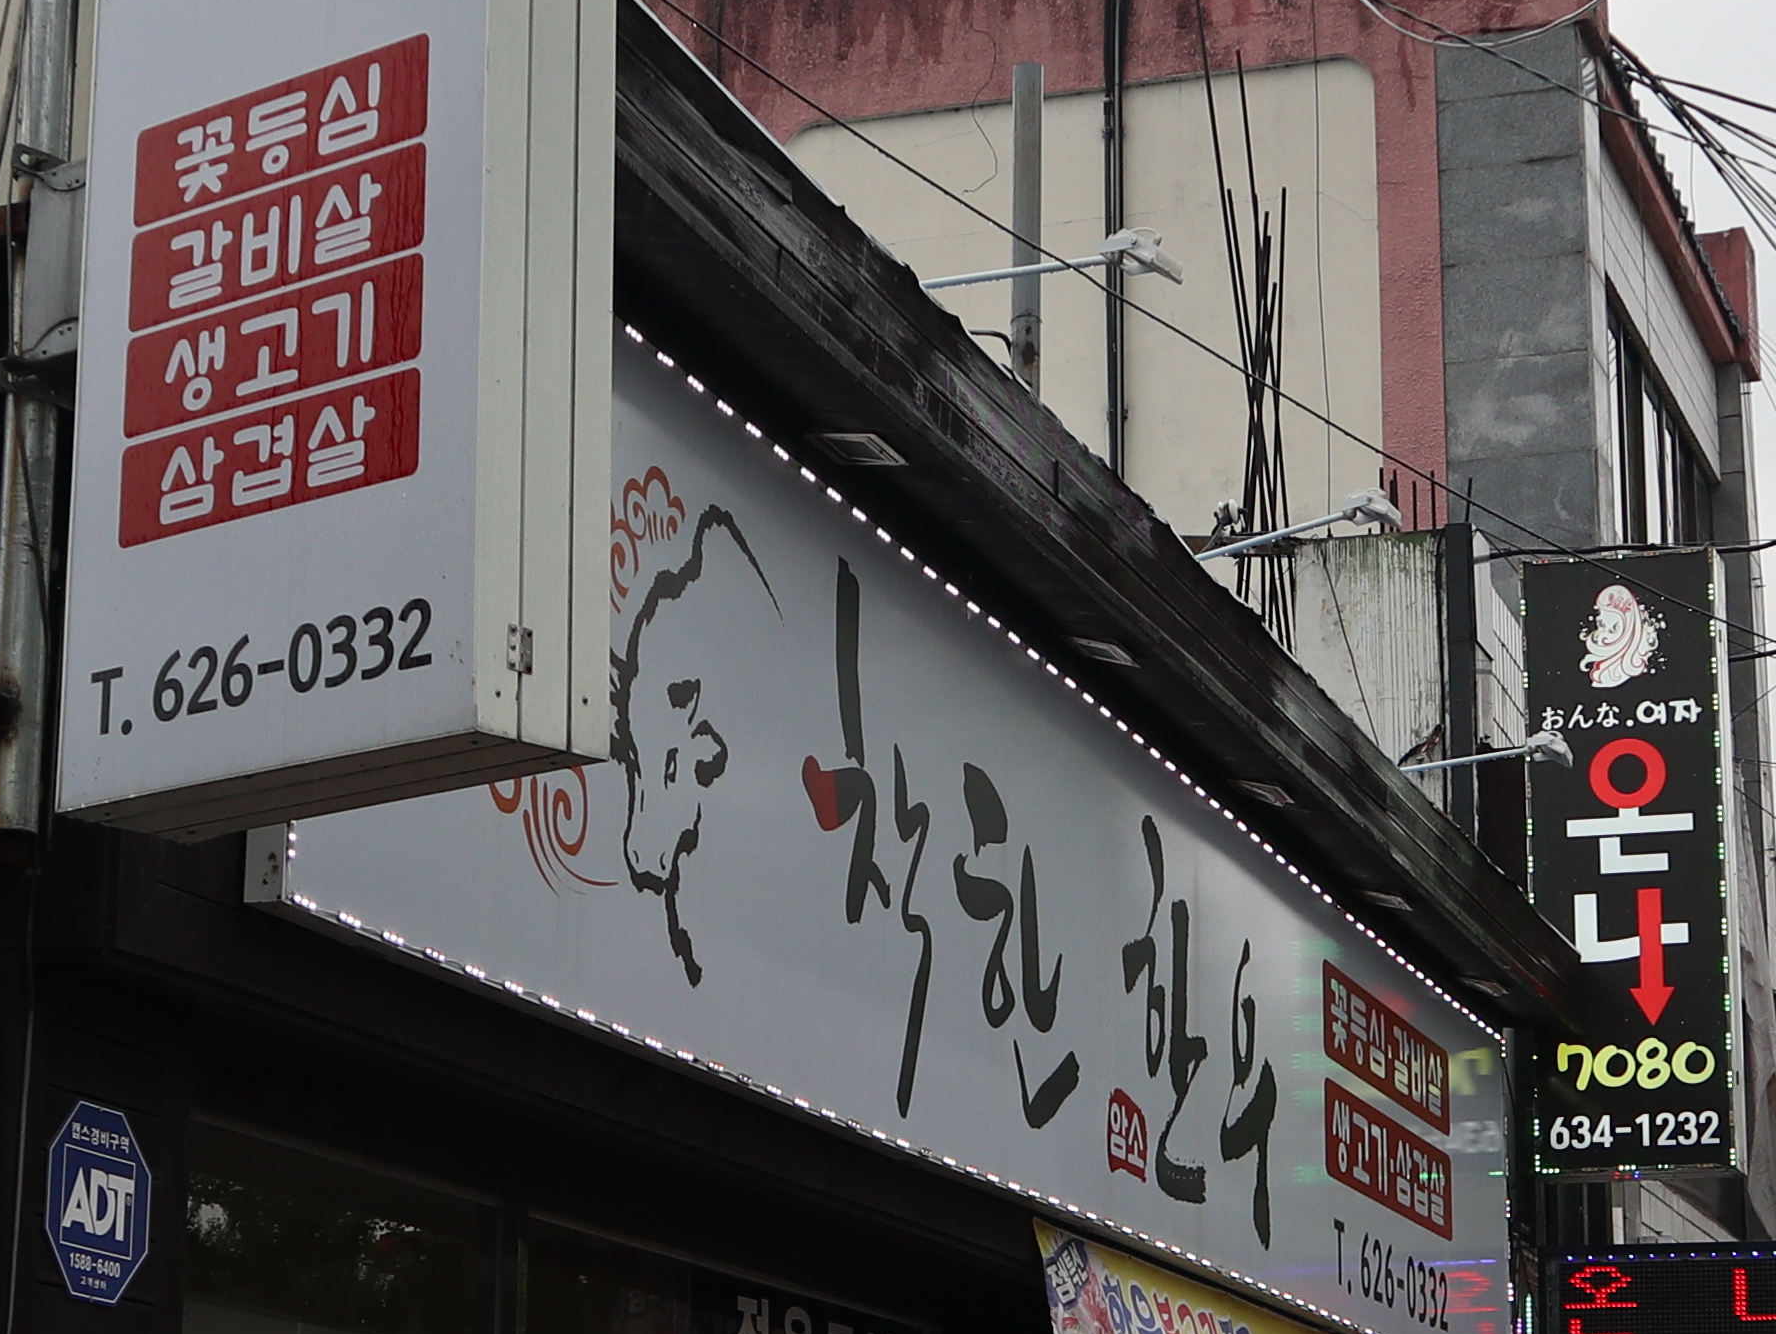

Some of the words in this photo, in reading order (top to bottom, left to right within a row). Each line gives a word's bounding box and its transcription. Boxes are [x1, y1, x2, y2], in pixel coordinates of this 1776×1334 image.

[174, 63, 381, 203] 꽃등심
[168, 172, 381, 310] 갈비살
[164, 280, 374, 411] 생고기
[158, 394, 376, 526] 삼겹살
[91, 667, 132, 735] T.
[153, 598, 433, 723] 626-0332
[802, 556, 1079, 1128] 착한
[1122, 814, 1278, 1250] 한우
[1566, 738, 1694, 1025] 온나
[1557, 1041, 1716, 1091] 7080
[71, 1122, 130, 1153] 캡스경비구역
[1109, 1100, 1146, 1174] 암소
[1549, 1110, 1720, 1151] 634-1232
[61, 1167, 135, 1242] ADT
[70, 1252, 120, 1278] 1588-6400
[1333, 1218, 1352, 1295] T.
[1360, 1232, 1449, 1332] 626-0332
